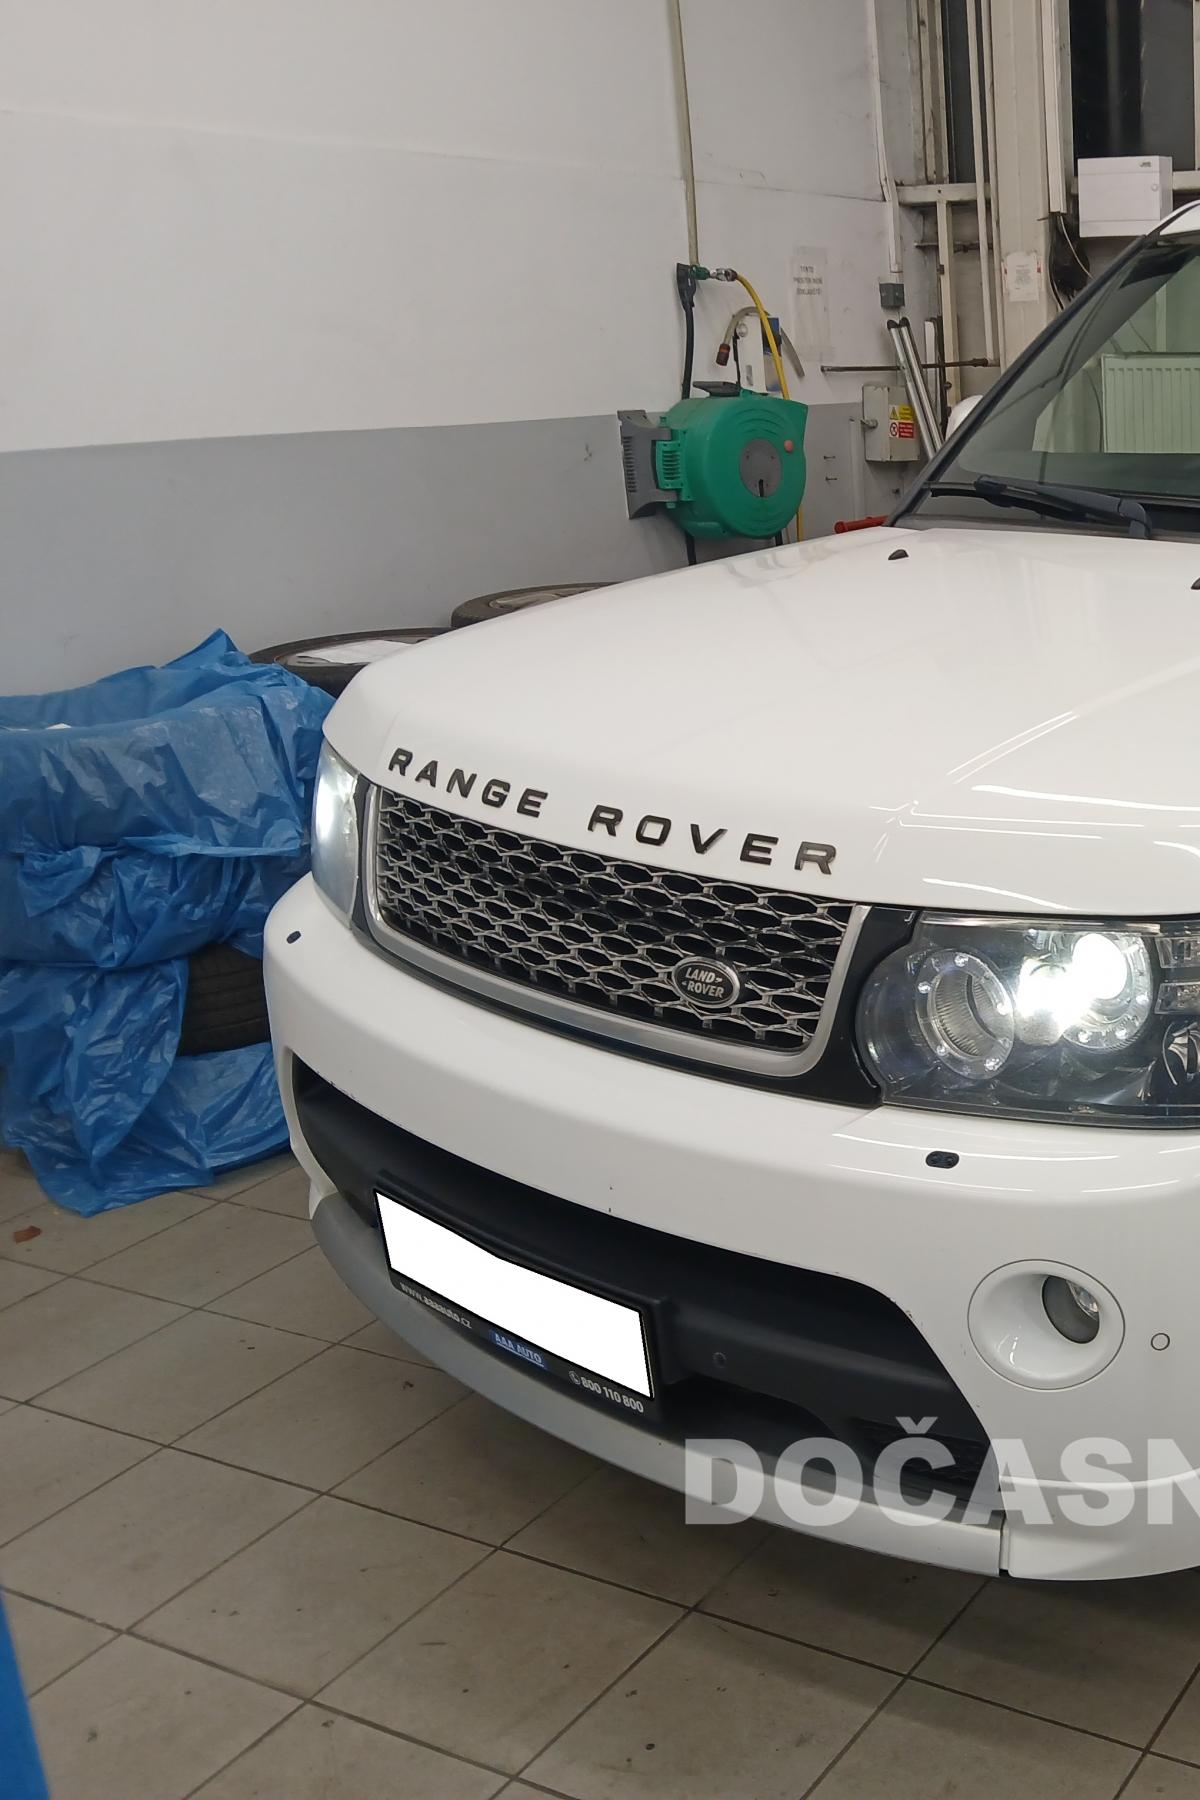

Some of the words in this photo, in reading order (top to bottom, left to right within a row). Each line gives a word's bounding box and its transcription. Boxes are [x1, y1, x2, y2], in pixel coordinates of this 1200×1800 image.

[388, 747, 549, 818] RANGE
[587, 804, 838, 875] ROVER
[685, 967, 716, 983] LAND
[687, 981, 725, 999] ROVER
[494, 1333, 515, 1350] AAA
[516, 1344, 543, 1364] AUTO
[580, 1376, 602, 1395] 800
[602, 1386, 622, 1403] 110
[622, 1394, 645, 1414] 800
